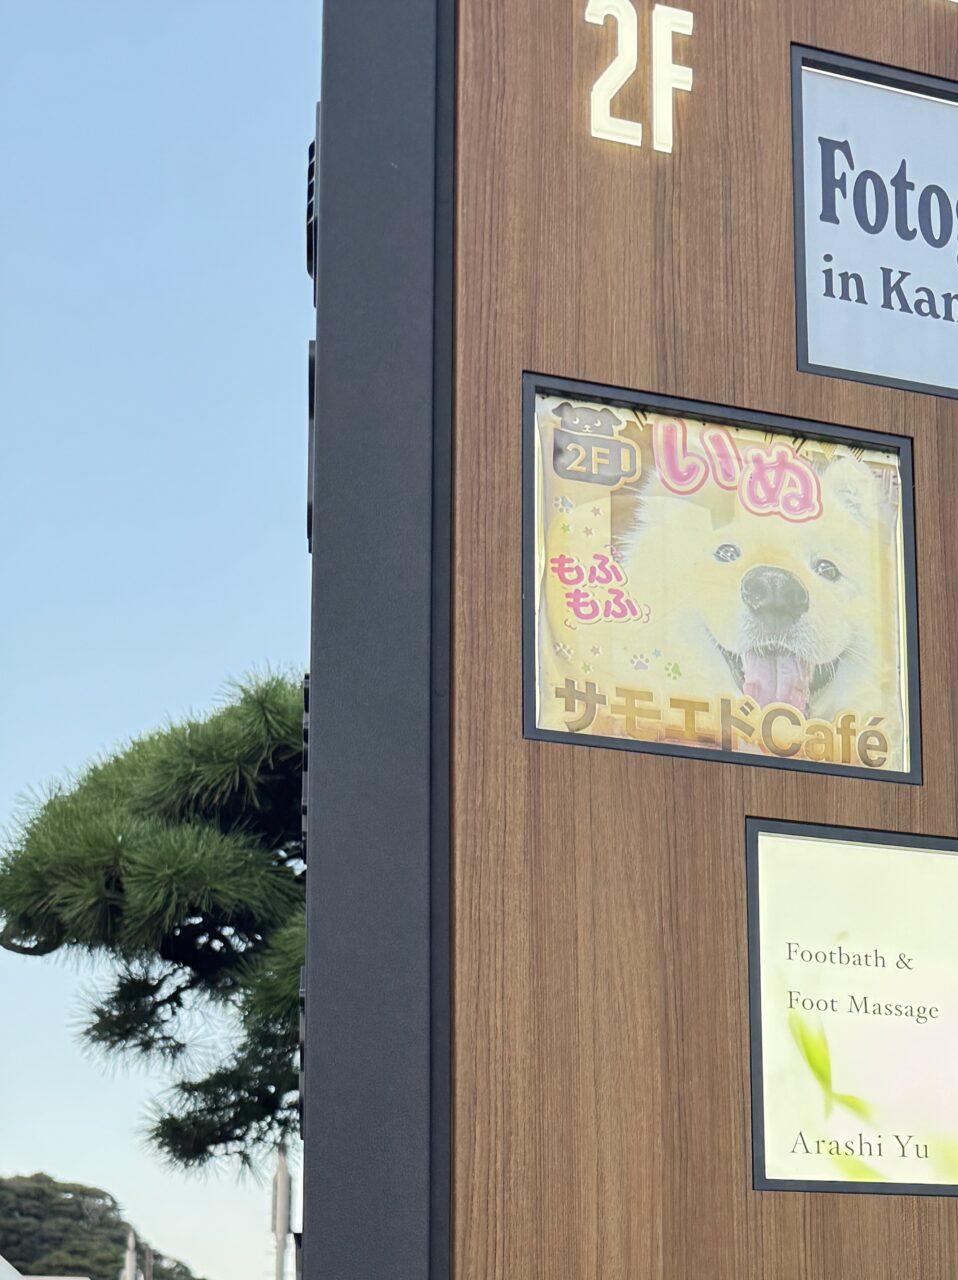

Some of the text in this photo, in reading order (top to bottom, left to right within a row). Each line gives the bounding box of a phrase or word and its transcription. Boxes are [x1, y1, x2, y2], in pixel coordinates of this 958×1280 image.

[584, 0, 693, 153] 2F
[823, 254, 866, 305] in
[566, 443, 610, 475] 2F
[655, 419, 822, 522] いぬ
[785, 942, 914, 971] Footbath &
[786, 990, 939, 1025] Foot Massage
[791, 1131, 929, 1159] Arashi Yu
